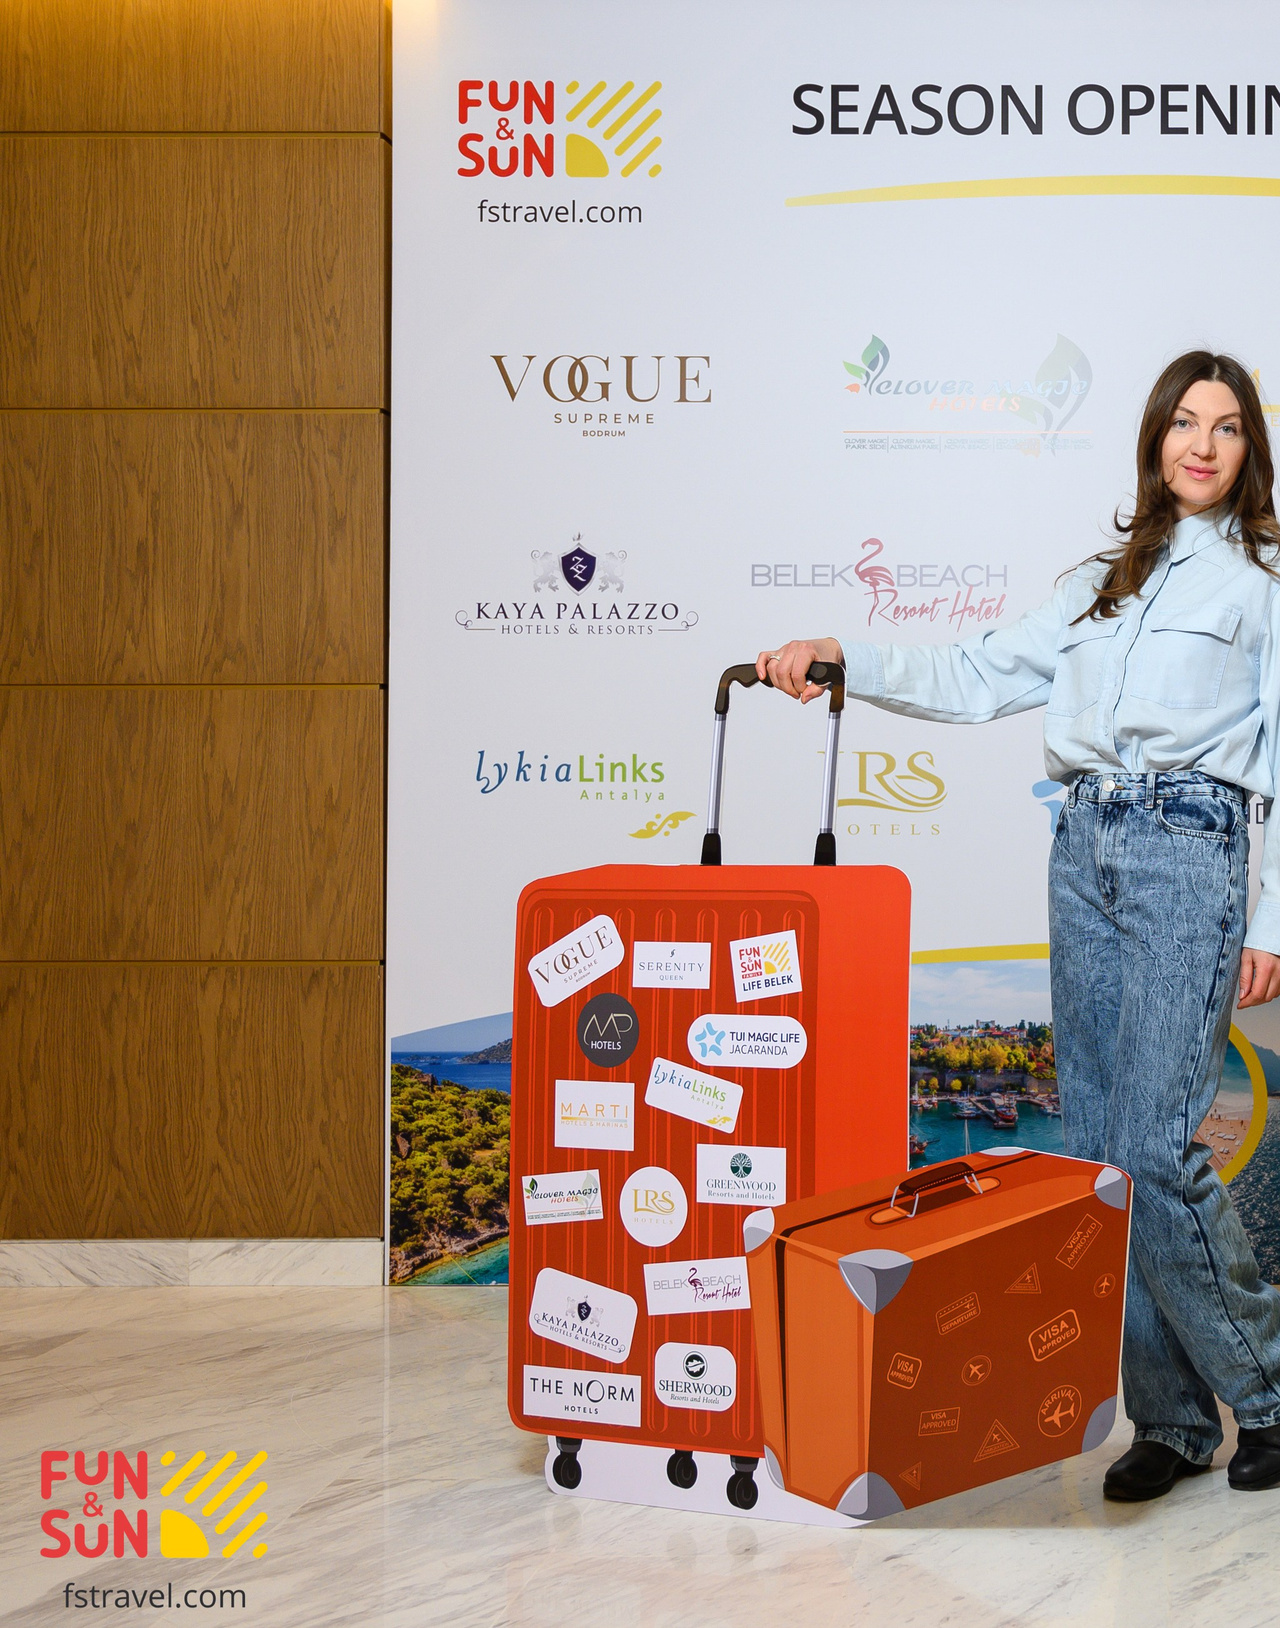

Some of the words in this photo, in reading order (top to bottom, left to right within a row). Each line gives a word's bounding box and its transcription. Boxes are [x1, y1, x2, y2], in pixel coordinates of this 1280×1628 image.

[458, 80, 554, 124] FUN
[791, 83, 1043, 136] SEASON
[496, 117, 515, 140] &
[457, 133, 554, 178] SUN
[477, 199, 643, 223] fstravel.com
[490, 354, 712, 403] VOGUE
[875, 379, 975, 396] CLOVER
[988, 379, 1089, 398] MAGIC
[554, 413, 655, 424] SUPREME
[751, 564, 855, 587] BELEK
[897, 564, 1008, 588] BEACH
[476, 603, 546, 620] KAYA
[556, 603, 679, 620] PALAZZO
[864, 587, 949, 627] Resort
[948, 585, 1007, 632] Hotel
[501, 625, 560, 635] HOTELS
[568, 623, 580, 635] &
[587, 625, 653, 635] RESORTS
[580, 789, 665, 802] Antalya
[848, 824, 941, 836] OTELS
[534, 925, 614, 985] VOGUE
[739, 946, 761, 961] FUN
[563, 958, 599, 984] SUPREME
[638, 961, 704, 972] SERENITY
[740, 958, 762, 973] SUN
[743, 981, 762, 991] LIFE
[764, 975, 793, 988] BELEK
[584, 1013, 633, 1045] MP
[729, 1032, 745, 1042] TUI
[747, 1032, 778, 1043] MAGIC
[781, 1033, 800, 1043] LIFE
[591, 1040, 621, 1050] HOTELS
[729, 1045, 788, 1056] JACARANDA
[561, 1102, 628, 1118] MARTI
[690, 1094, 725, 1111] Antalya
[706, 1178, 776, 1192] GREENWOOD
[534, 1190, 564, 1200] CLOVER
[707, 1190, 735, 1198] Resorts
[736, 1191, 749, 1199] and
[751, 1192, 775, 1200] Hotels
[634, 1217, 674, 1225] HOTELS
[1066, 1230, 1084, 1250] VISA
[1066, 1221, 1097, 1265] APPROVED
[653, 1278, 688, 1290] BELEK
[702, 1274, 741, 1286] BEACH
[942, 1309, 978, 1332] DEPARTURE
[542, 1312, 568, 1329] KAYA
[571, 1323, 619, 1347] PALAZZO
[549, 1325, 573, 1338] HOTELS
[581, 1337, 608, 1351] RESORTS
[1039, 1319, 1069, 1343] VISA
[1037, 1327, 1076, 1355] APPROVED
[897, 1359, 914, 1374] VISA
[890, 1370, 914, 1384] APPROVED
[530, 1377, 563, 1395] THE
[573, 1379, 634, 1403] NORM
[658, 1379, 732, 1397] SHERWOOD
[670, 1393, 689, 1402] Resorts
[690, 1395, 701, 1403] and
[702, 1396, 720, 1405] Hotels
[1040, 1388, 1076, 1415] ARRIVAL
[564, 1404, 599, 1415] HOTELS
[930, 1411, 947, 1420] VISA
[921, 1418, 957, 1430] APPROVED
